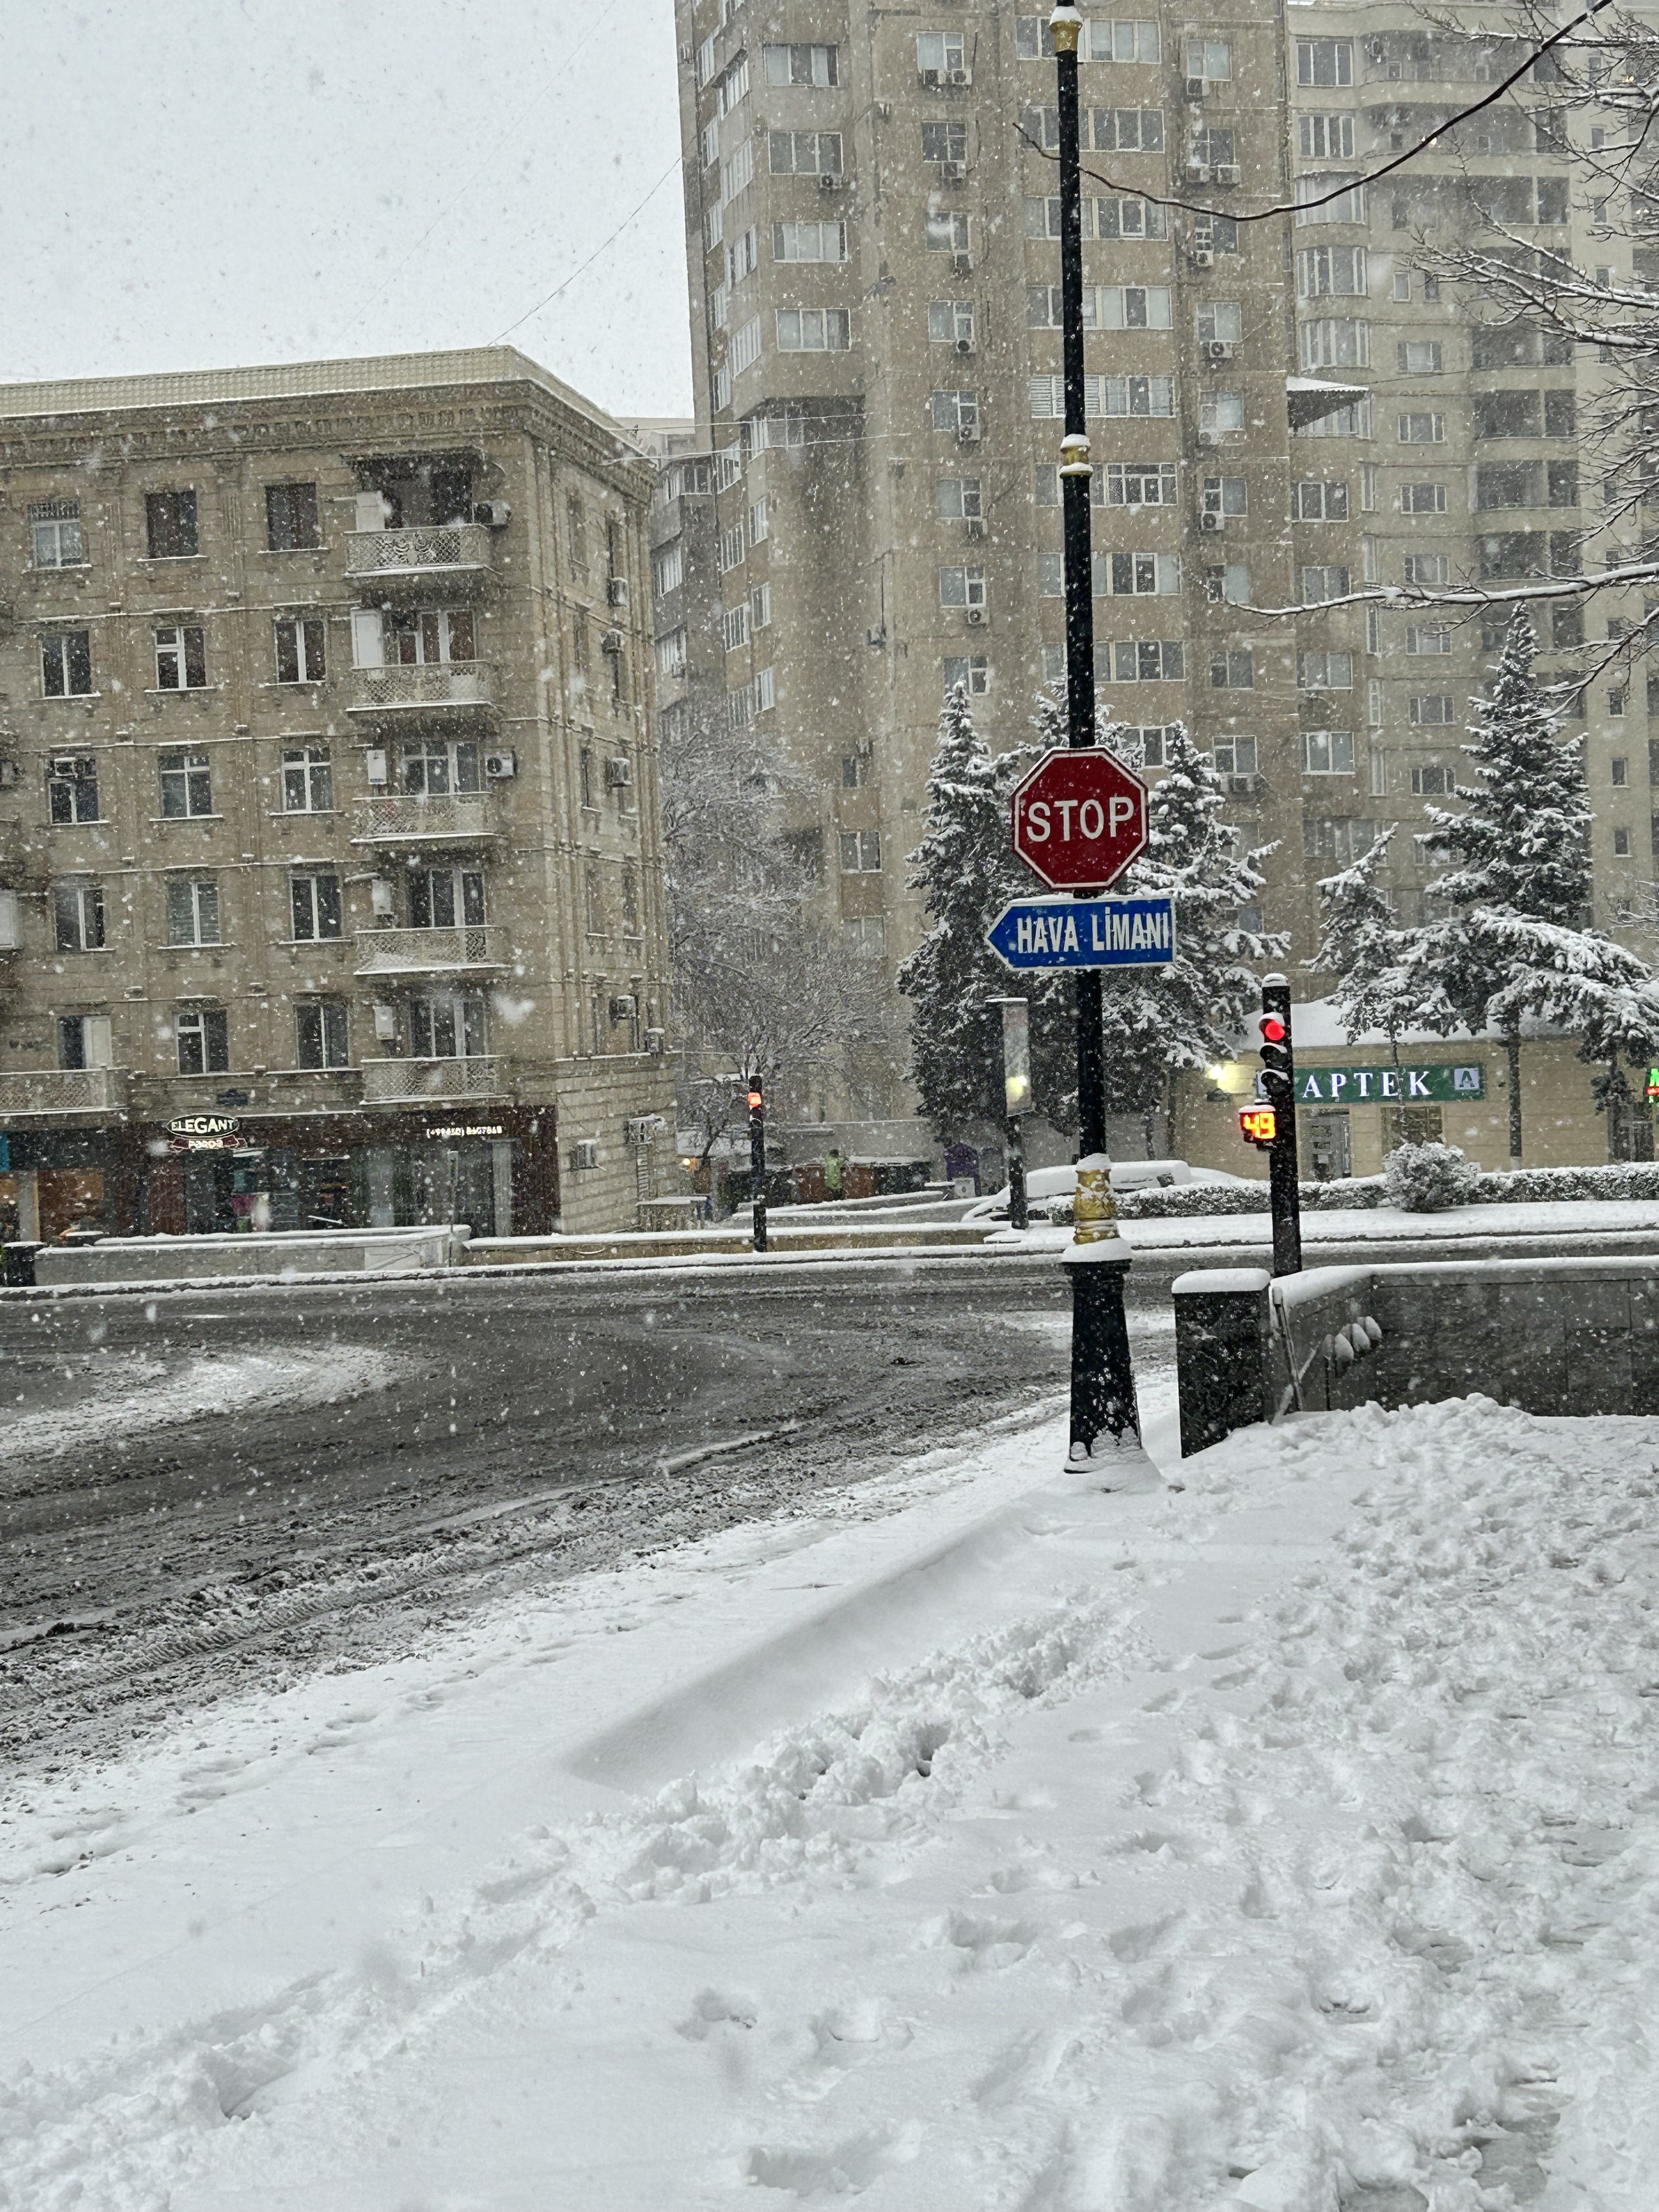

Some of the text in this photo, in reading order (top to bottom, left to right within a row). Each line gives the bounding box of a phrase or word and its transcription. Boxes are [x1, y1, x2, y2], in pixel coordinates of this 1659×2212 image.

[1026, 796, 1135, 842] STOP
[1017, 906, 1169, 953] HAVA LİMANI
[1302, 1071, 1433, 1098] APTEK
[171, 1117, 234, 1134] ELEGANT
[1243, 1113, 1276, 1139] 49
